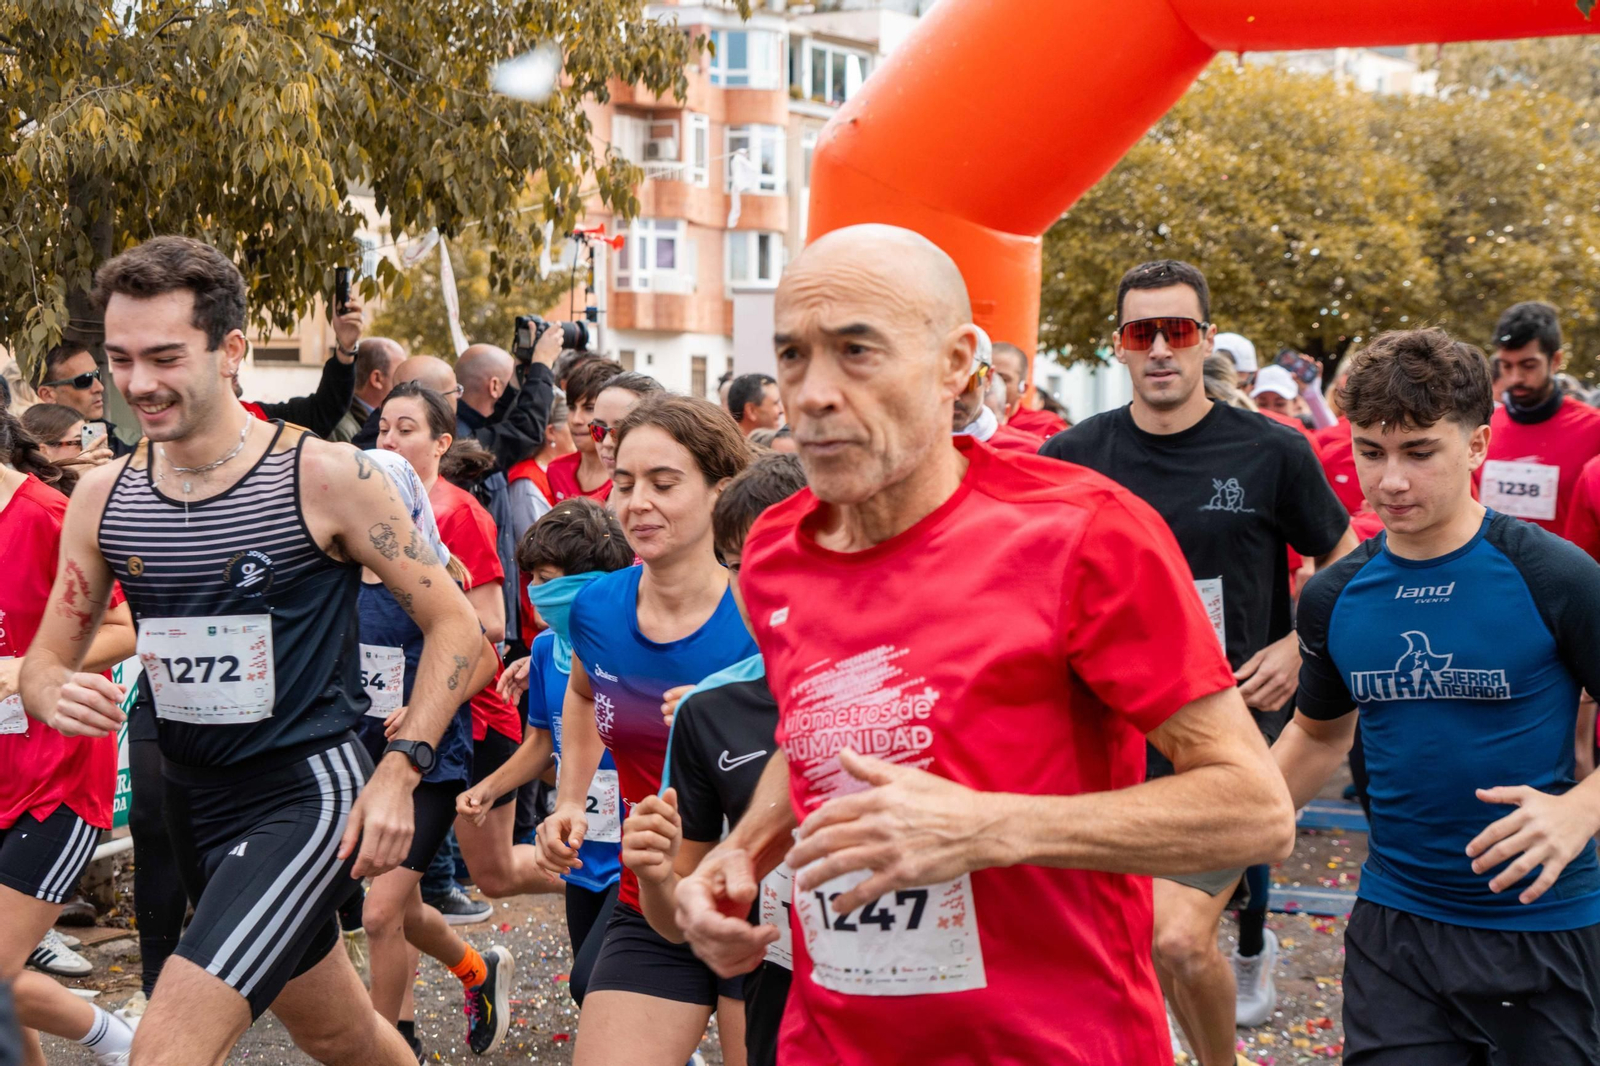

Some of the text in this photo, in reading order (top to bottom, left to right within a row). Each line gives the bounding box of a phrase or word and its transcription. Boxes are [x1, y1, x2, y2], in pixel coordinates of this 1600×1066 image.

[1498, 481, 1540, 497] 1238
[246, 550, 273, 565] JOVEN
[1395, 581, 1456, 599] land
[160, 655, 242, 684] 1272
[1352, 667, 1502, 700] ULTRA SIERRA
[1441, 684, 1508, 699] NEVADA
[897, 695, 932, 720] de
[781, 725, 934, 762] HUMANIDAD
